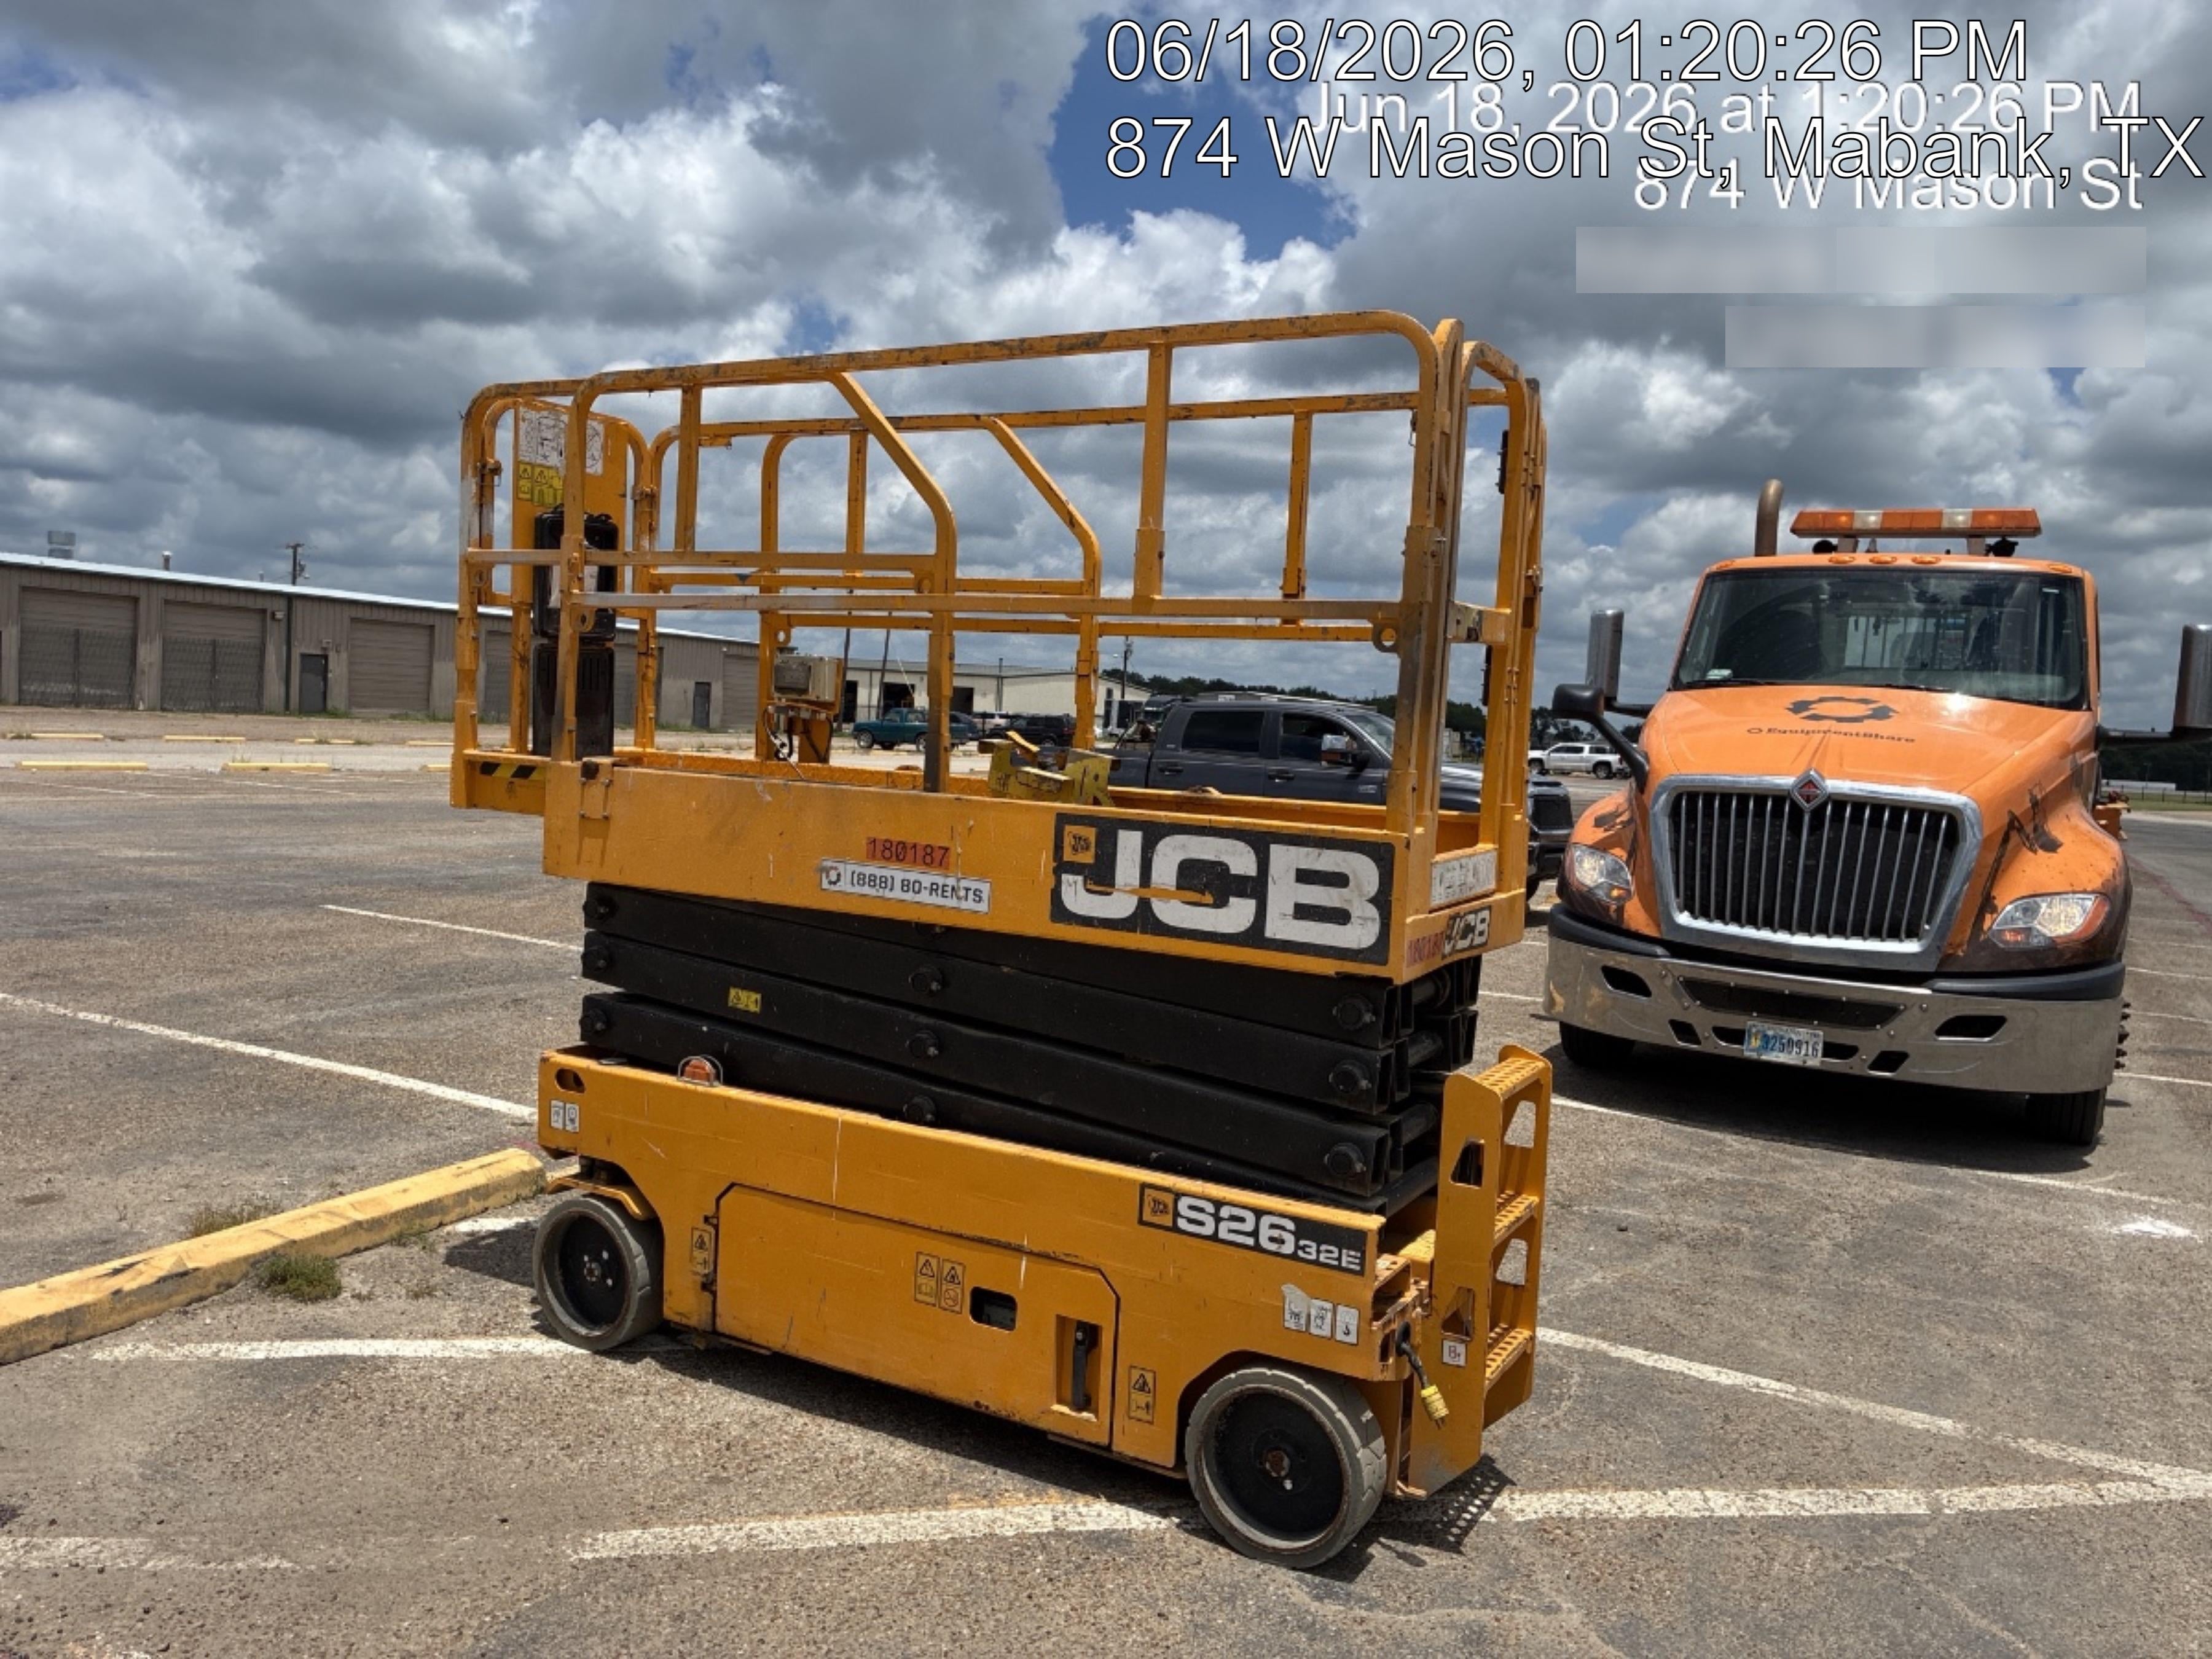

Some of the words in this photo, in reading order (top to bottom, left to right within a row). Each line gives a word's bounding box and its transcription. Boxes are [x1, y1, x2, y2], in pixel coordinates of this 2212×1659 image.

[867, 837, 951, 867] 180187
[850, 869, 895, 891] (888)
[1060, 829, 1380, 951] JCB
[1445, 908, 1490, 955] JCB
